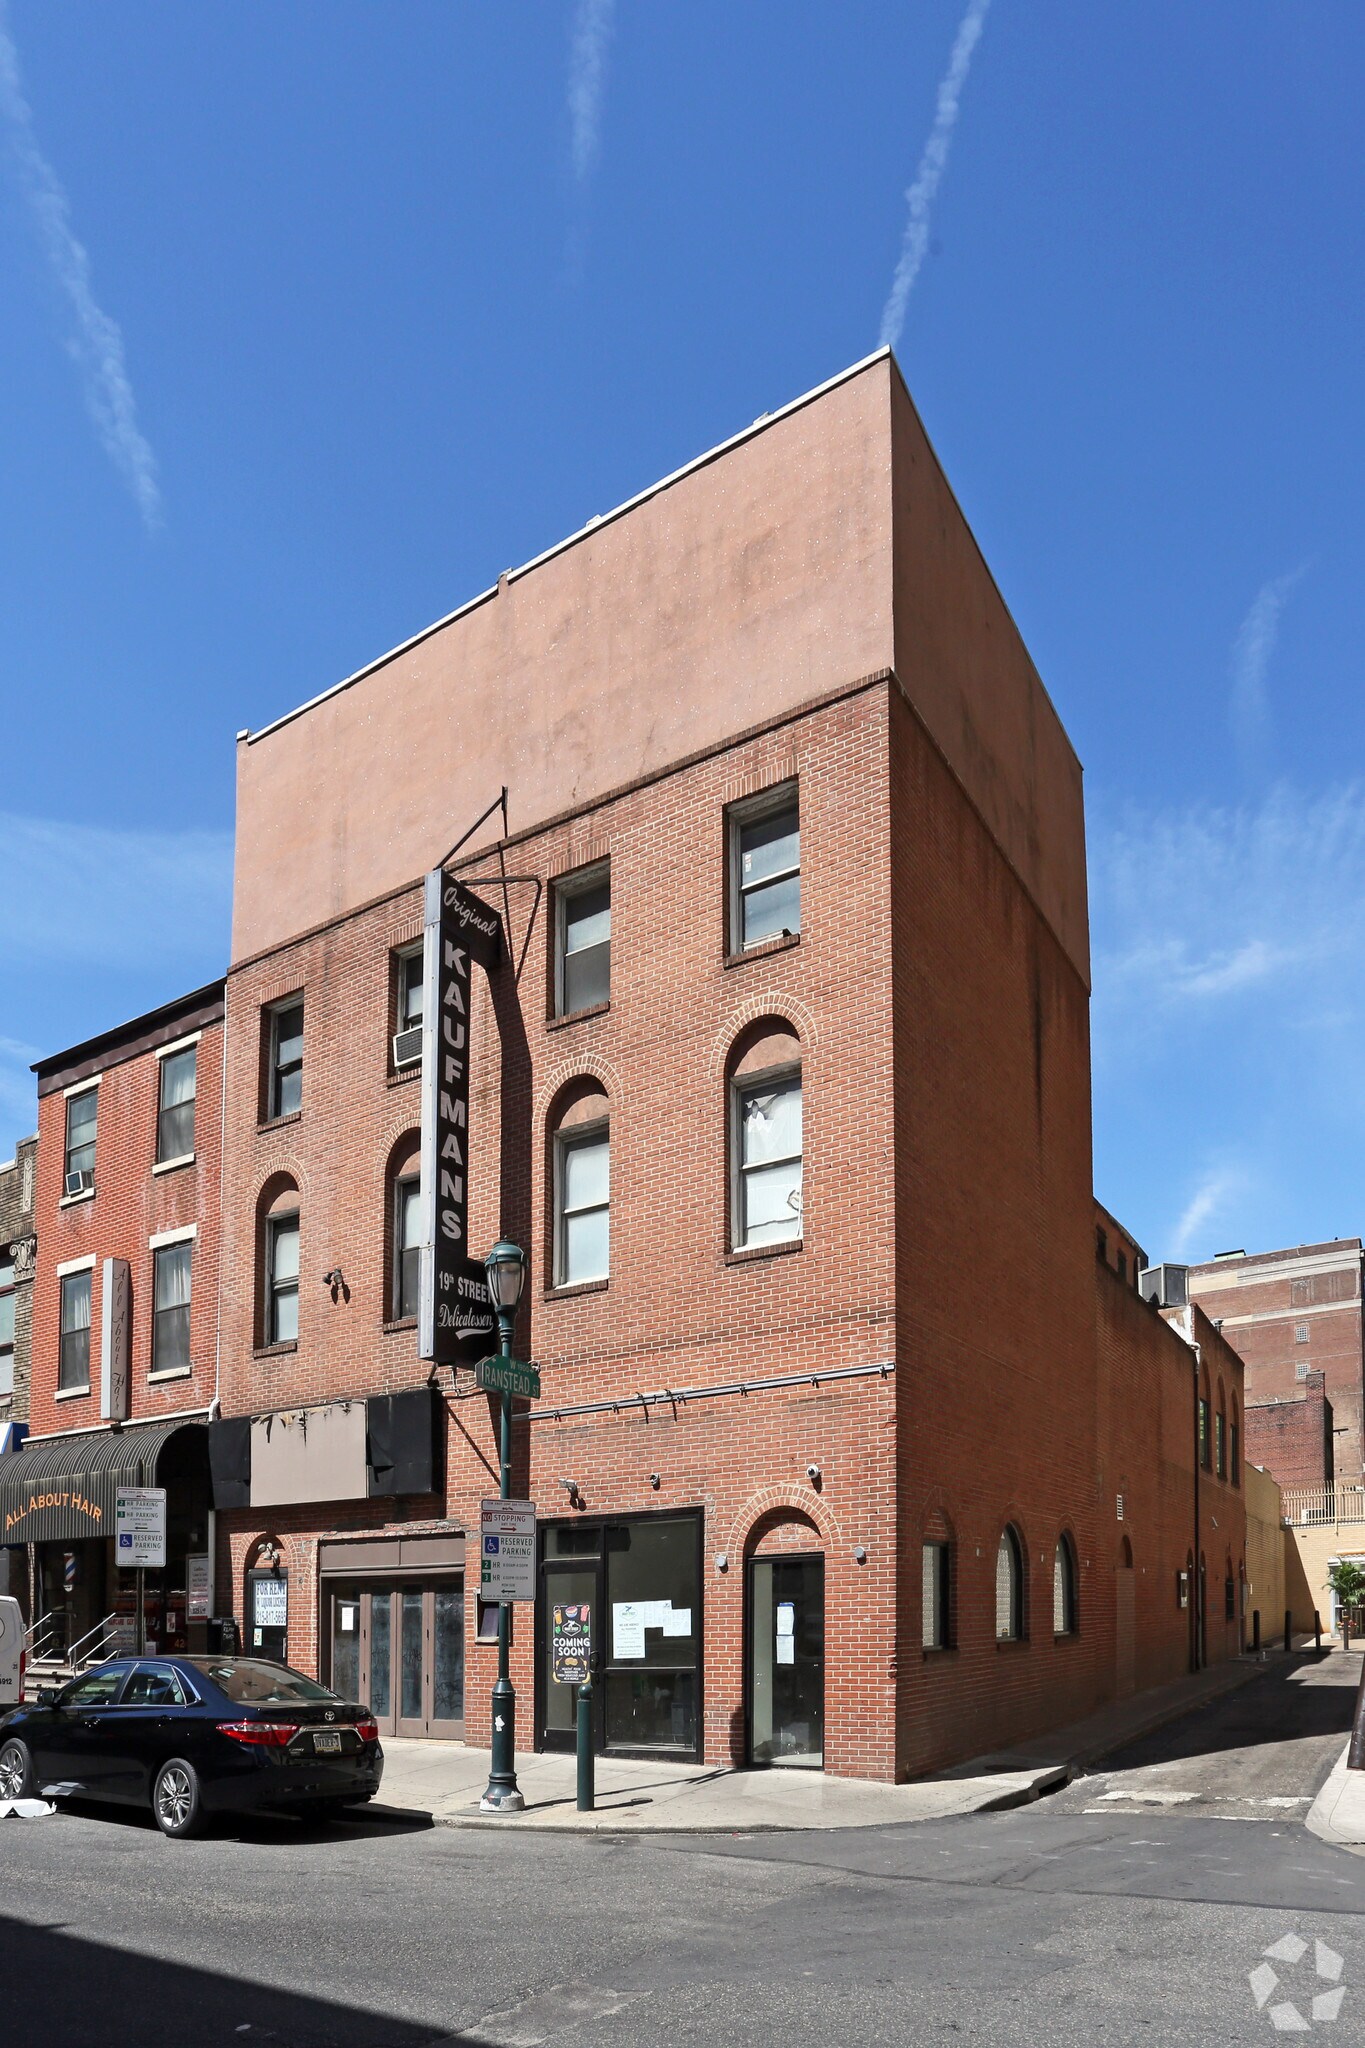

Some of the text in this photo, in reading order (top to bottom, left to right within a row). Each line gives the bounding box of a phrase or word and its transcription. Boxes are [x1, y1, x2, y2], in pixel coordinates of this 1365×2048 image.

[444, 887, 497, 936] Original
[440, 939, 467, 1240] KAUFMANS
[439, 1270, 492, 1304] 19th STREET
[438, 1304, 494, 1328] Delicatessen
[485, 1366, 539, 1397] RANSTEAD ST
[6, 1492, 102, 1531] ALL ABOUT HAIR
[483, 1513, 492, 1522] NO
[256, 1582, 286, 1595] FOR RENT
[553, 1638, 590, 1647] COMING
[558, 1648, 584, 1656] SOON
